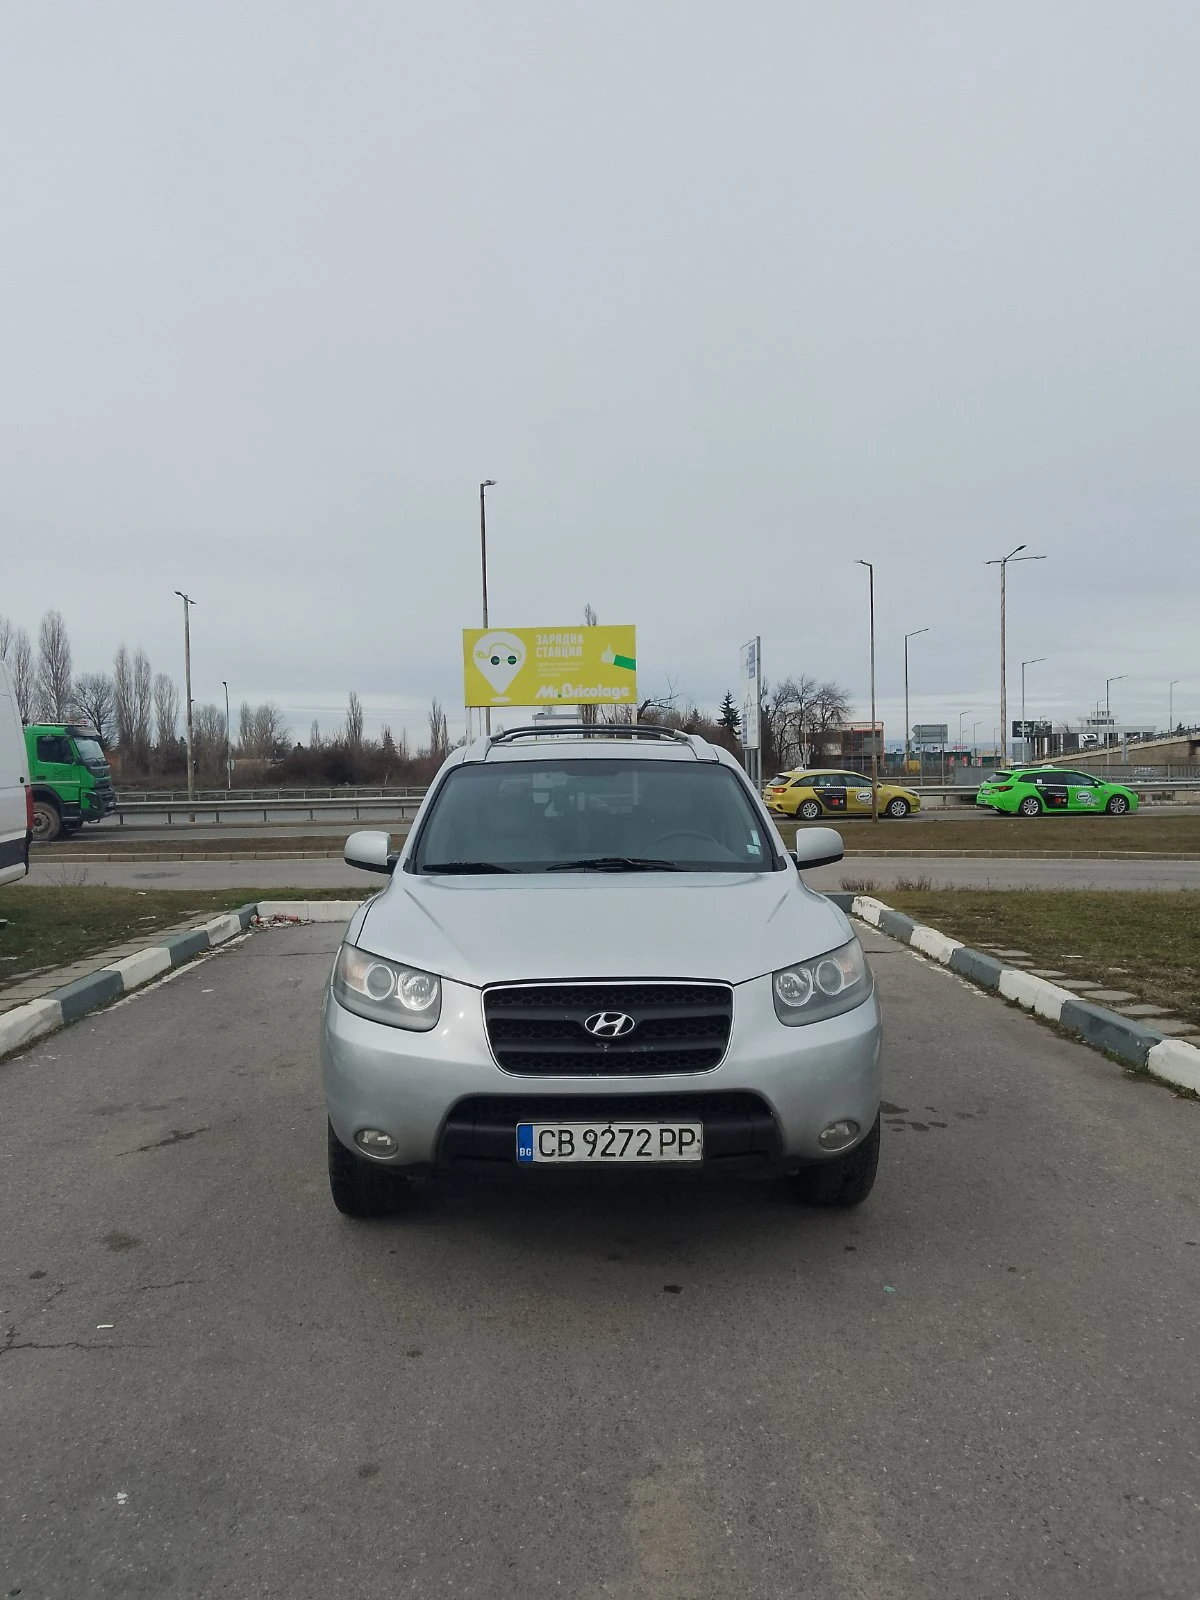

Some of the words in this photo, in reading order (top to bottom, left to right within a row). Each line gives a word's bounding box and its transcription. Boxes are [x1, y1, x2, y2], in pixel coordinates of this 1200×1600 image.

[536, 633, 584, 645] ЗАРЯДНА
[536, 645, 582, 658] СТАНЦИЯ
[538, 1129, 576, 1157] CB
[582, 1129, 652, 1157] 9272
[659, 1128, 696, 1156] PP
[519, 1147, 532, 1157] BG
